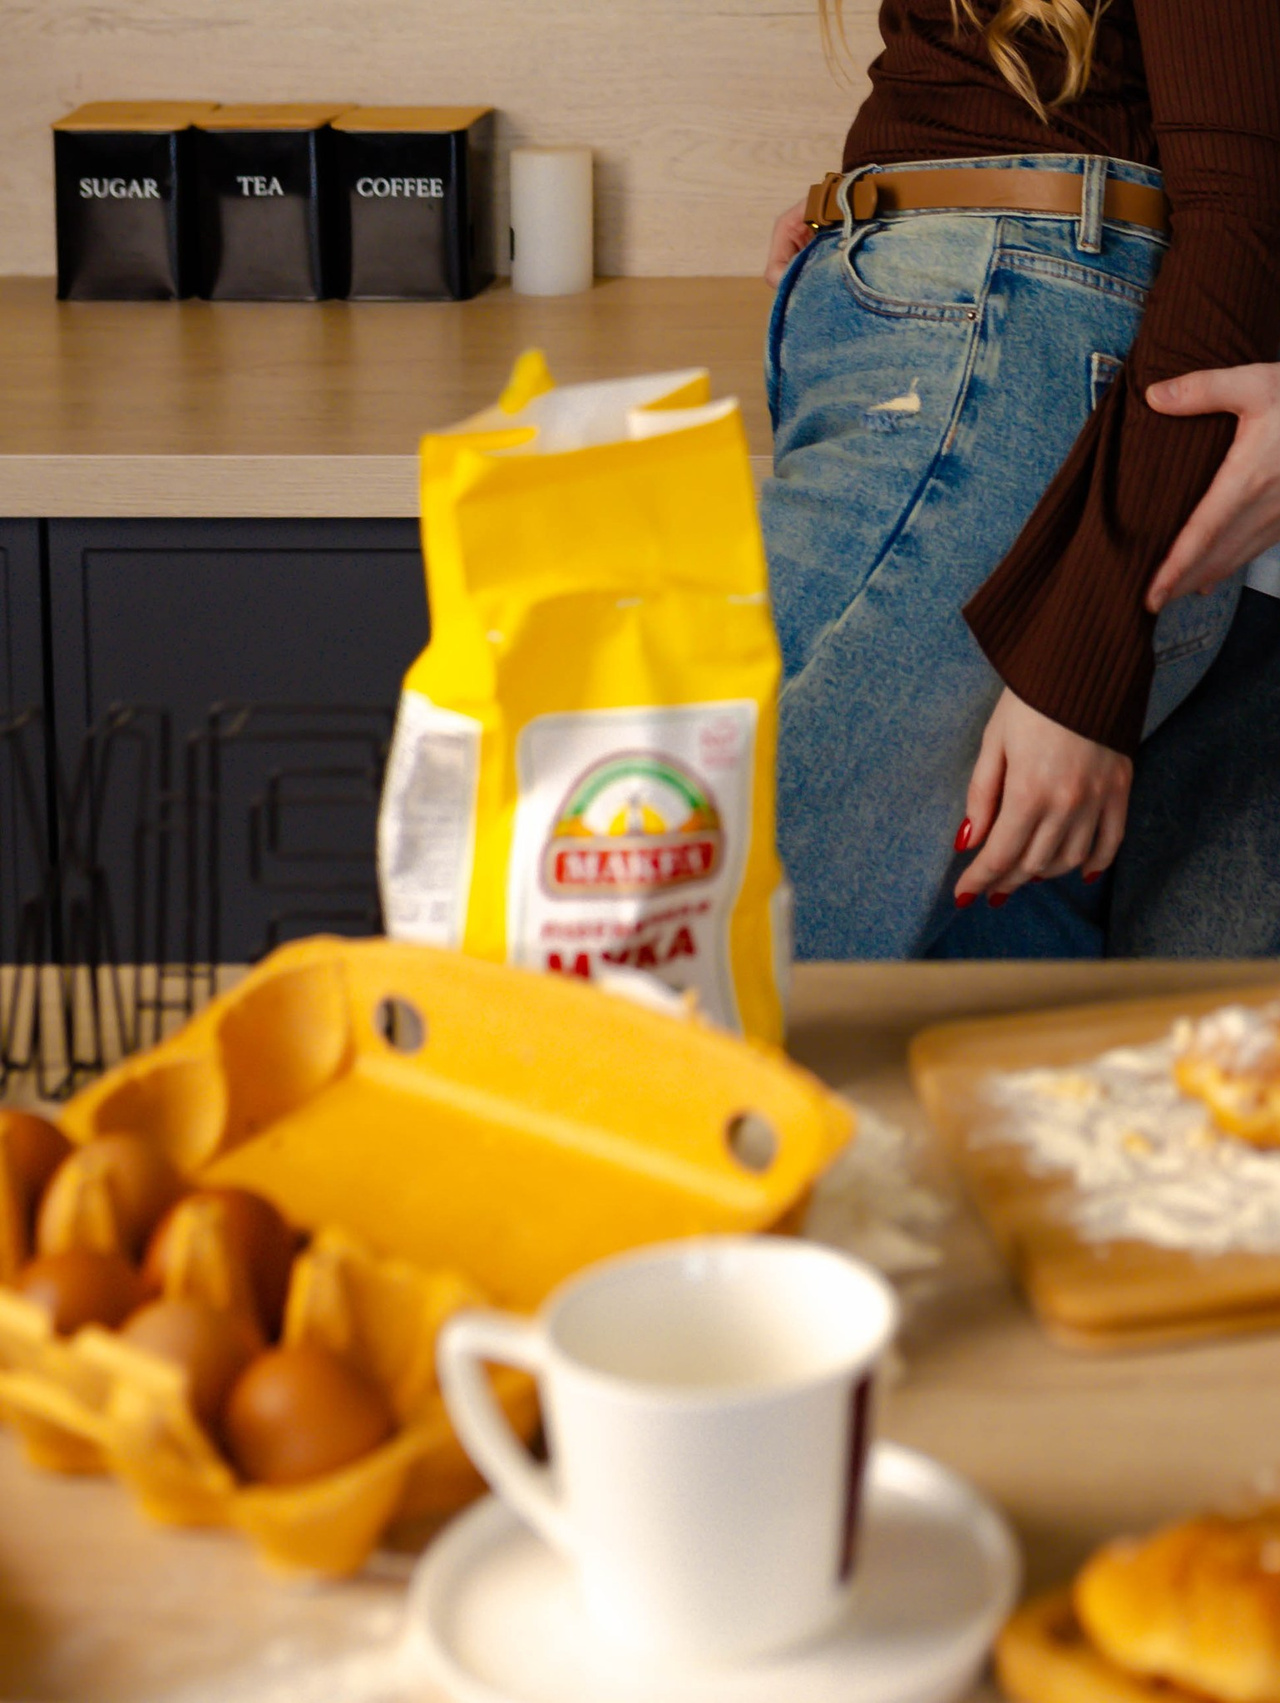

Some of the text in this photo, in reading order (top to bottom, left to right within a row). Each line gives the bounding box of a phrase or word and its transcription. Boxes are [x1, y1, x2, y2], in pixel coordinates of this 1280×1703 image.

[79, 178, 162, 199] SUGAR
[236, 175, 285, 197] TEA
[356, 177, 445, 198] COFFEE
